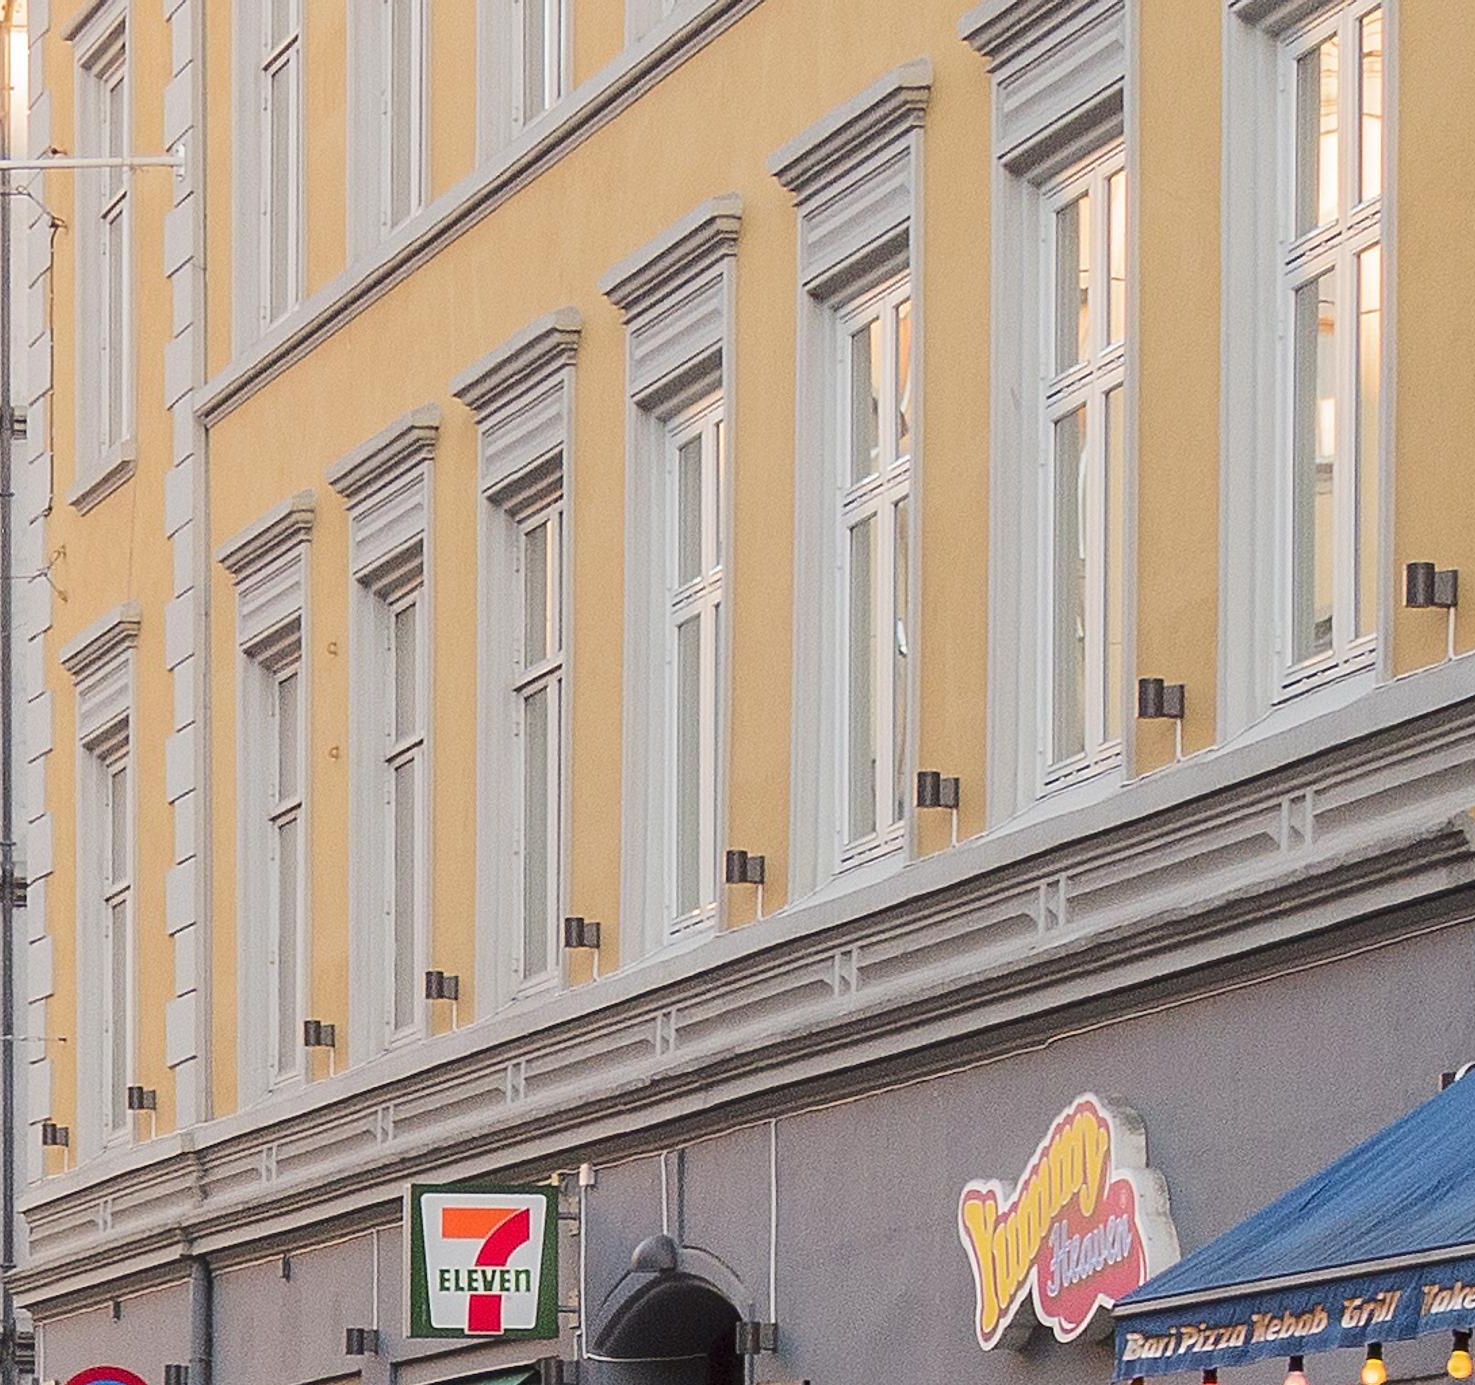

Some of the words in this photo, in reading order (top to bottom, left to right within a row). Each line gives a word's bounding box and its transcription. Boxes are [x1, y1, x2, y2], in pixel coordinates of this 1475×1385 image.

[962, 1110, 1110, 1334] Yummy
[1048, 1213, 1133, 1298] Heaven
[1123, 1326, 1178, 1362] Bari
[1180, 1321, 1248, 1355] Pizza
[1250, 1304, 1329, 1346] Kebab
[1341, 1290, 1402, 1329] Grill
